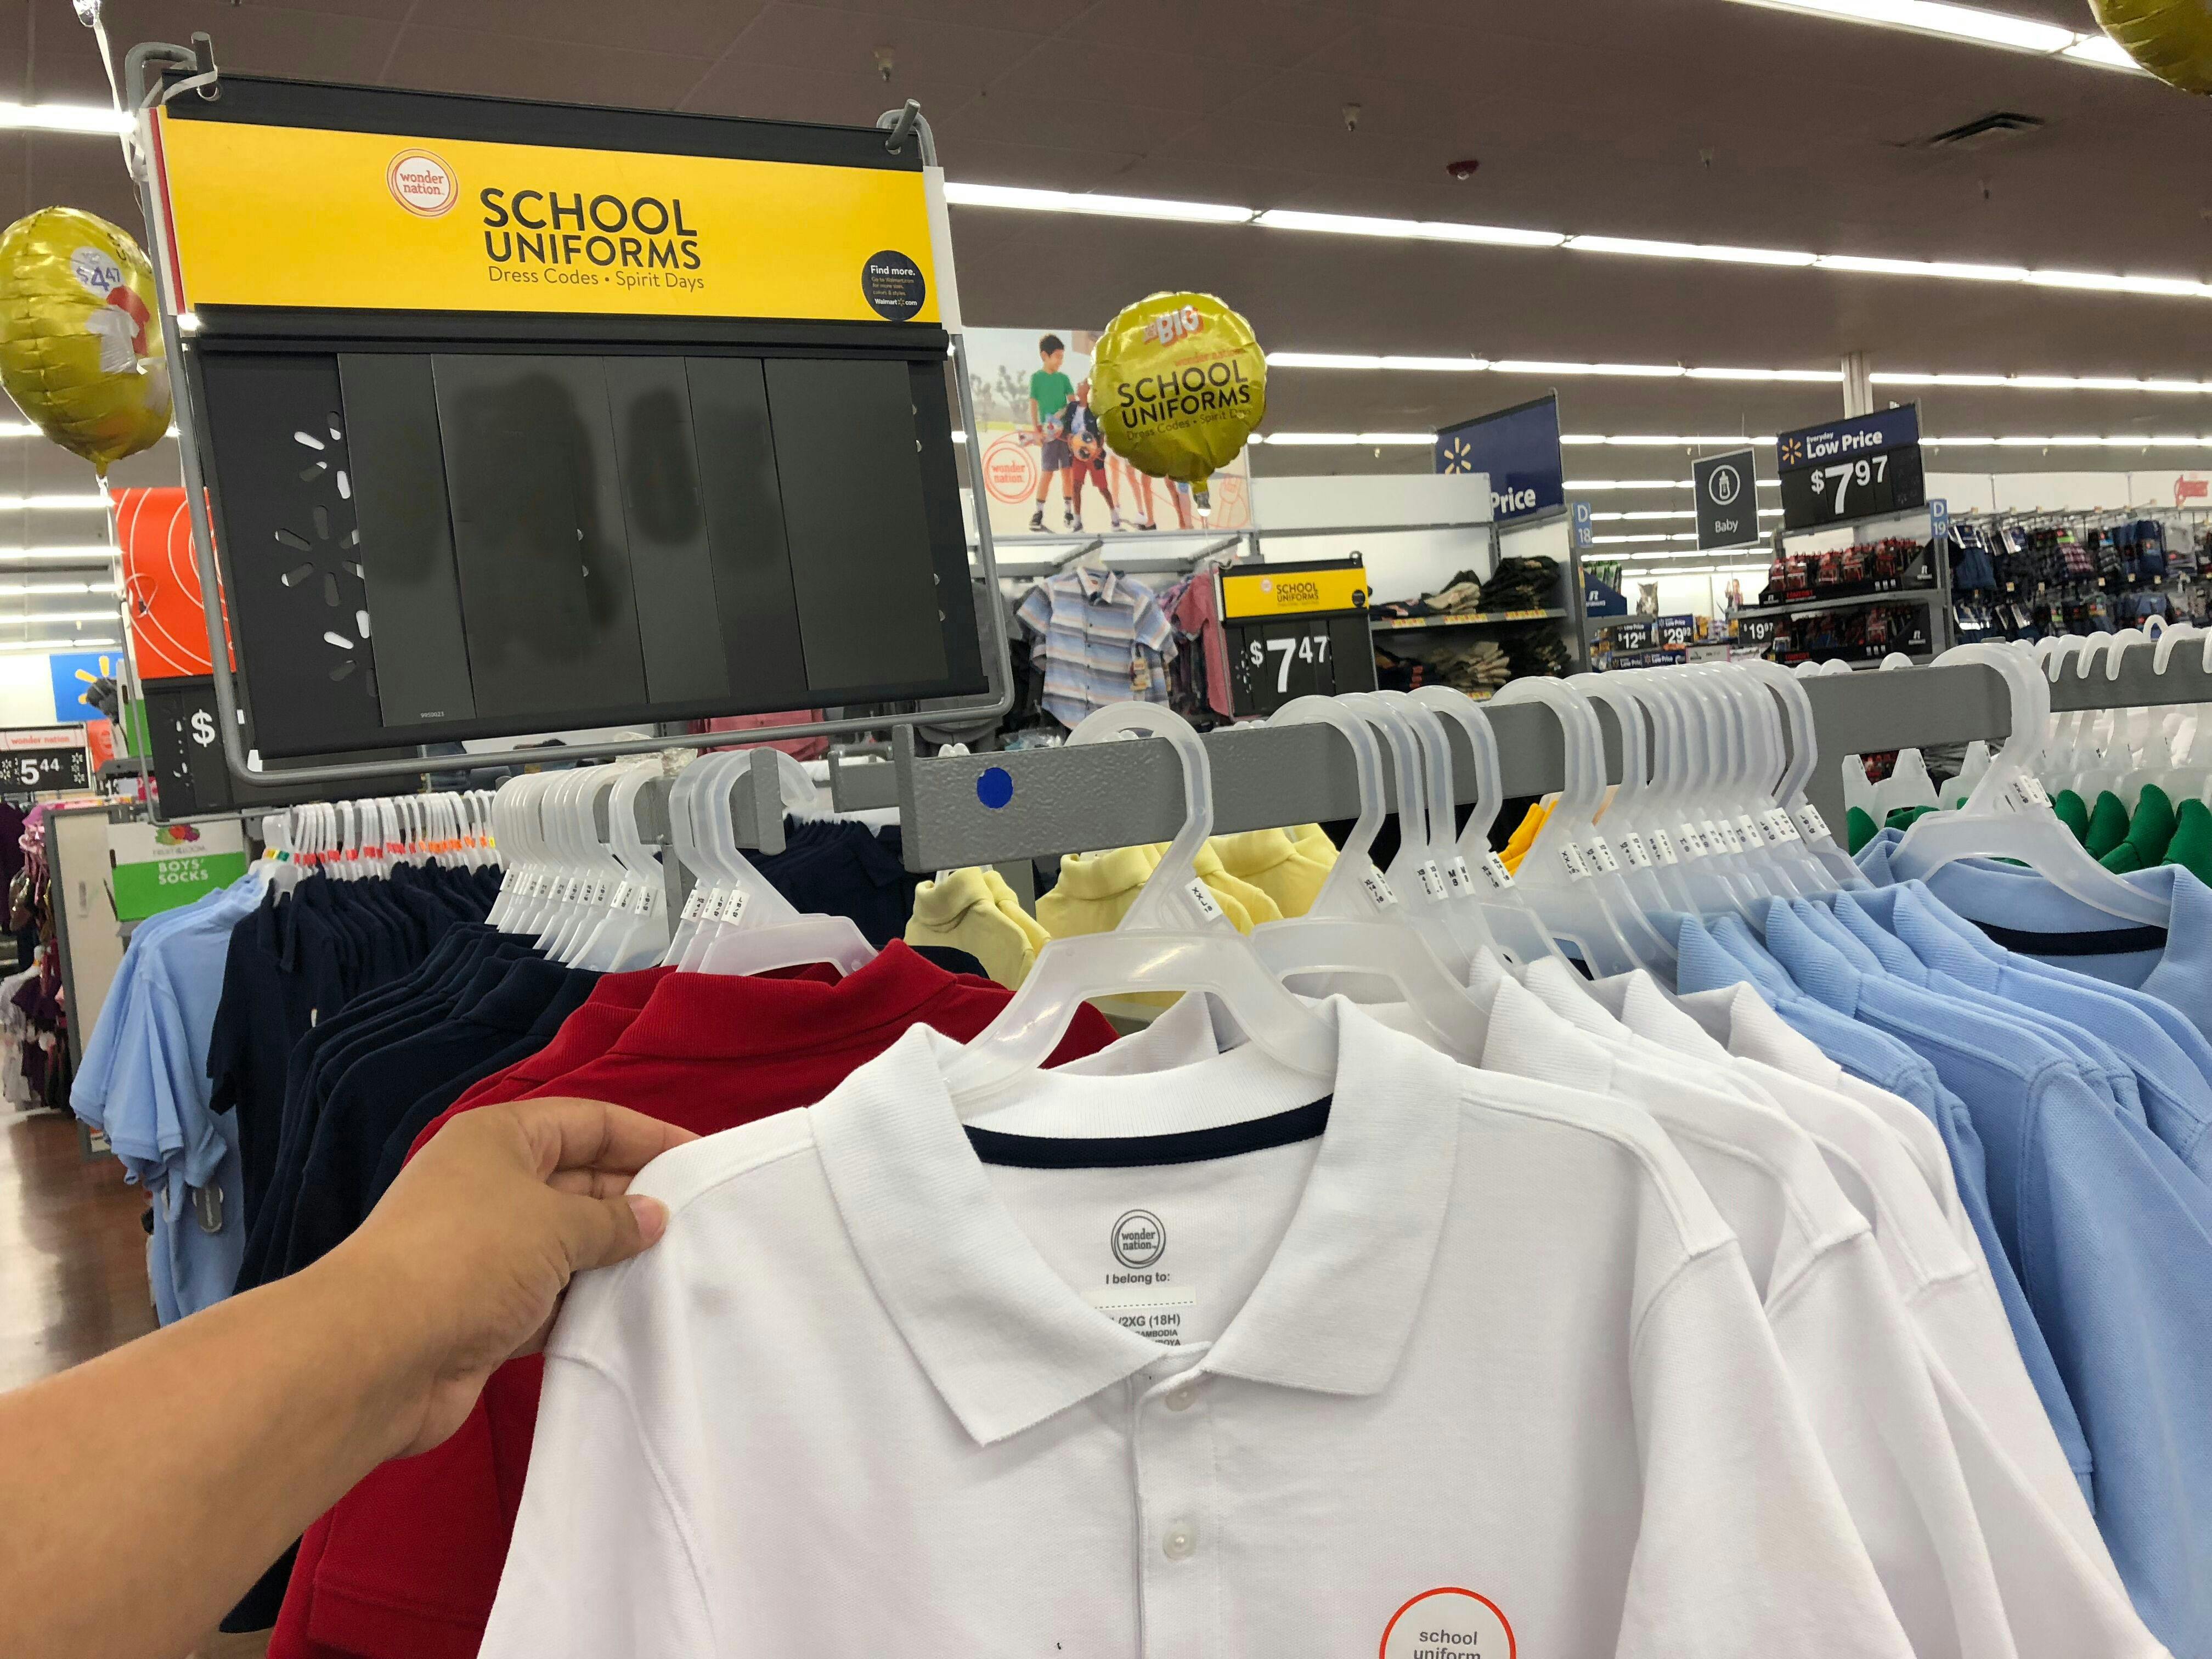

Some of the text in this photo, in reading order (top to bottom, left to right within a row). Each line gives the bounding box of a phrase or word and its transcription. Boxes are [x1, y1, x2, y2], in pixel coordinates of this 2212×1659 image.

[399, 170, 444, 184] wonder
[403, 183, 441, 195] nation
[480, 187, 698, 236] SCHOOL
[484, 230, 701, 270] UNIFORMS
[870, 265, 889, 274] Find
[489, 266, 704, 292] Dress Codes Spirit Days
[1156, 304, 1202, 346] BIG
[1117, 359, 1248, 408] SCHOOL
[1121, 384, 1251, 428] UNIFORMS
[1126, 427, 1155, 440] Dress
[1157, 419, 1190, 433] Codes
[1807, 430, 1883, 460] Low Price
[1577, 504, 1588, 522] D
[1933, 501, 1944, 518] D
[1714, 518, 1739, 533] Baby
[1933, 521, 1946, 535] 19
[1578, 527, 1592, 544] 18
[1276, 582, 1318, 594] SCHOOL
[1277, 592, 1319, 602] UNIFORMS
[158, 858, 205, 873] BOYS'
[158, 869, 208, 885] SOCKS
[1121, 1227, 1155, 1240] wonder
[1122, 1240, 1152, 1250] nation
[1105, 1272, 1170, 1284] I belong to:
[1149, 1313, 1181, 1328] (18H)
[1419, 1629, 1477, 1645] school
[1413, 1647, 1481, 1659] uniform
